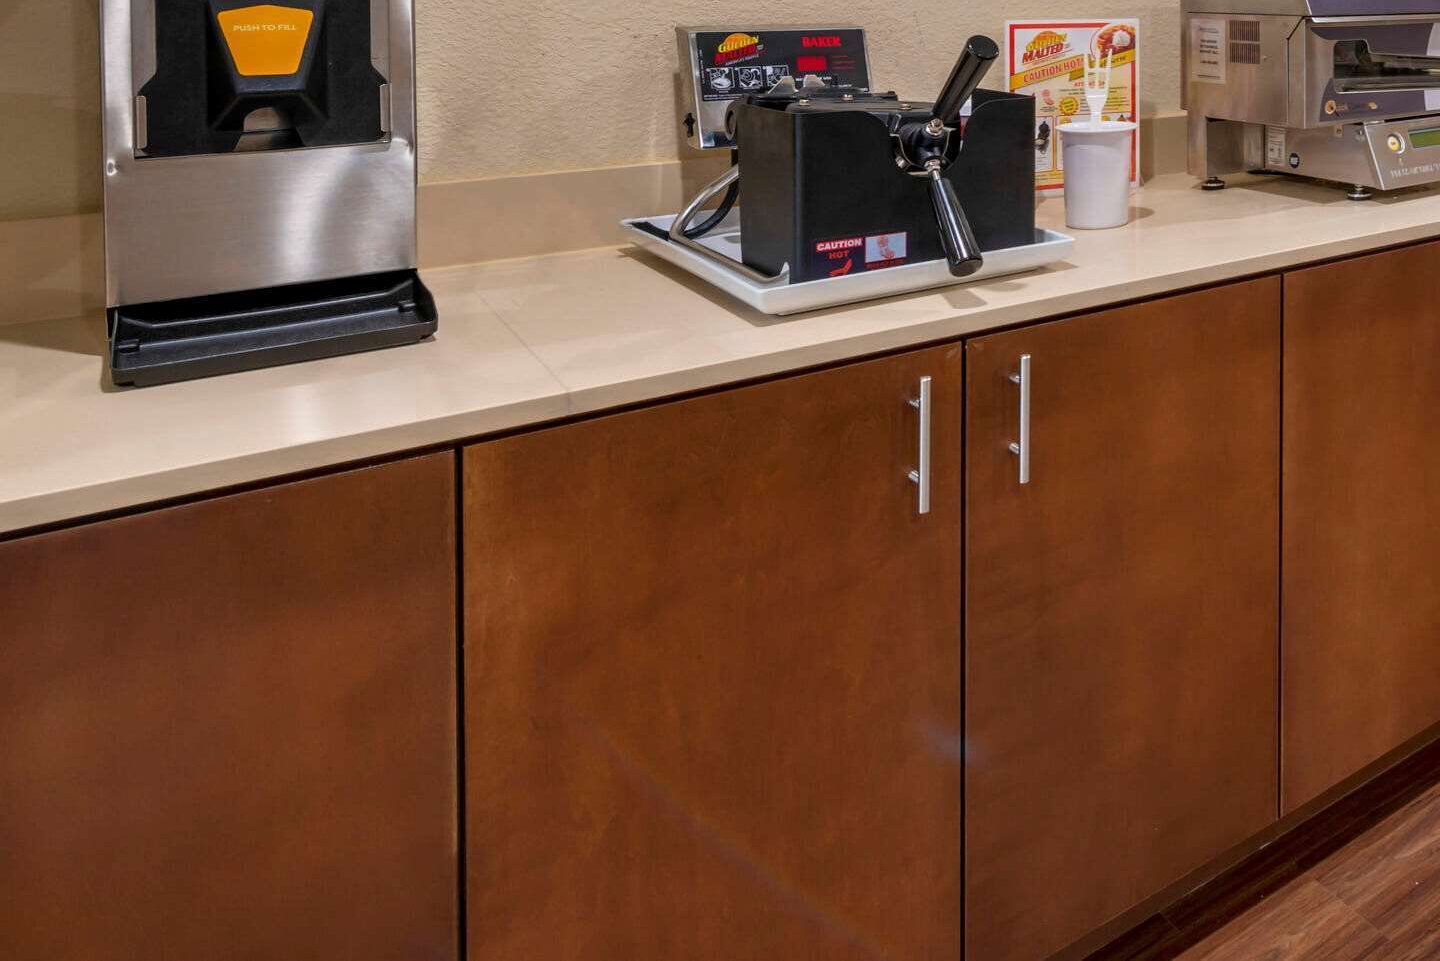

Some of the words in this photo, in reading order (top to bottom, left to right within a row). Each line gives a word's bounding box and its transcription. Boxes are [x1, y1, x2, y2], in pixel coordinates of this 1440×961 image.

[802, 36, 842, 48] BAKER
[1023, 42, 1064, 64] MALTED
[1023, 66, 1061, 83] CAUTION
[816, 238, 862, 252] CAUTION
[828, 250, 849, 259] HOT
